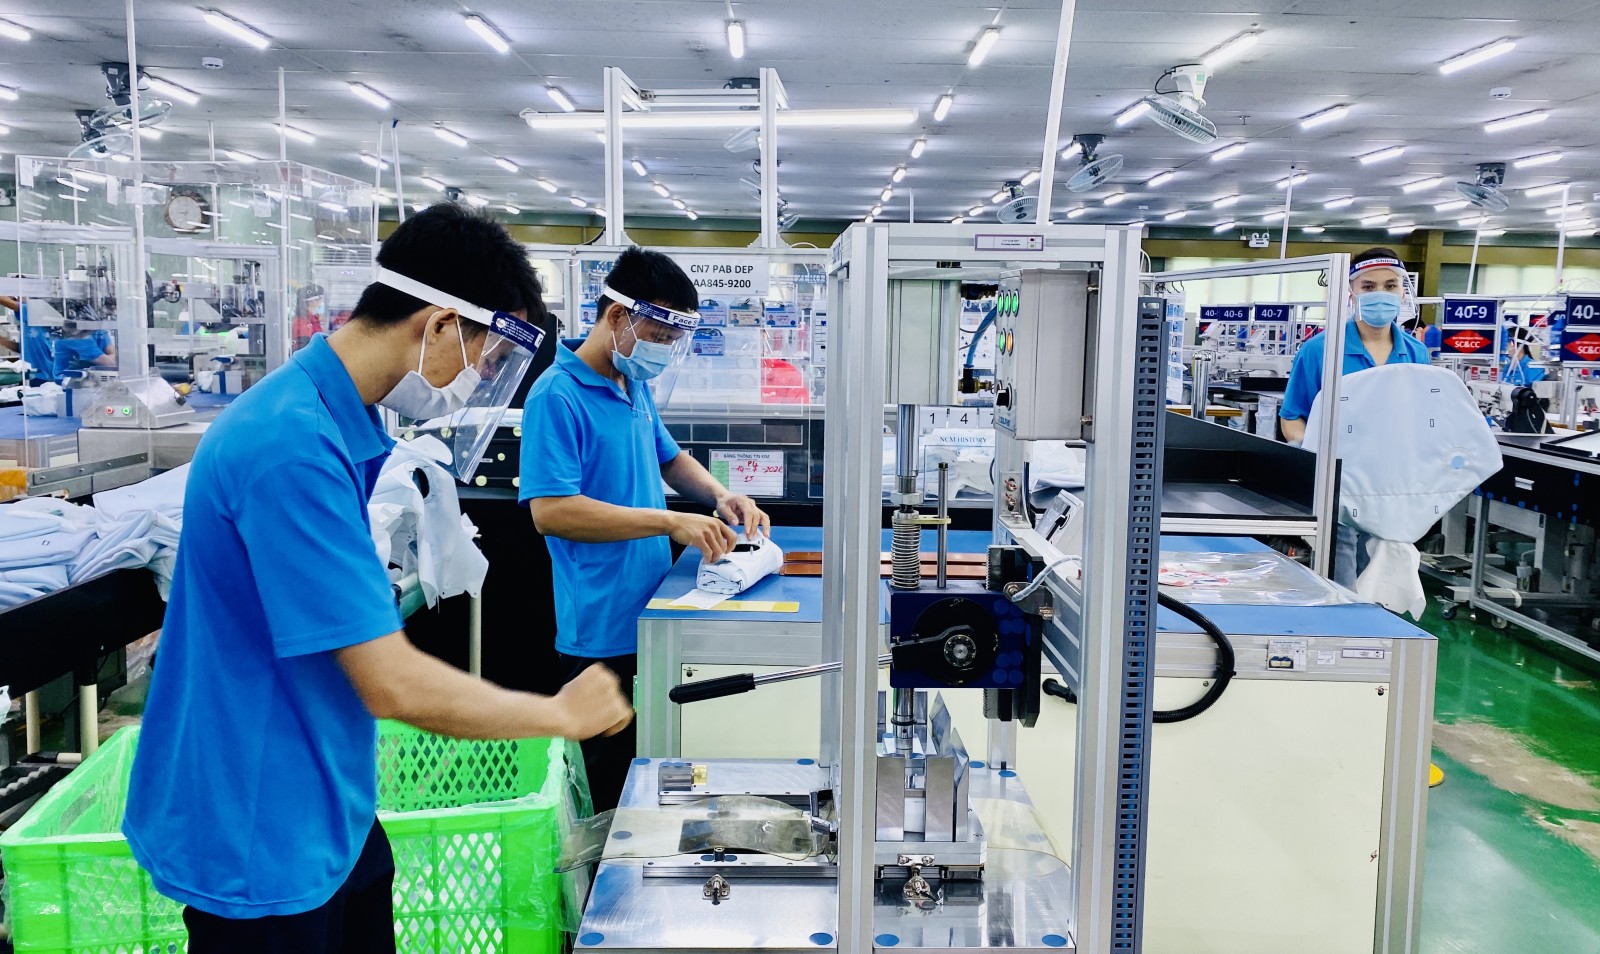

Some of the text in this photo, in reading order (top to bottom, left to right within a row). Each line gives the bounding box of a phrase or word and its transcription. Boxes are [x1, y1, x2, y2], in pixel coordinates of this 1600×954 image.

[690, 264, 754, 274] CN7 PAB DEP
[693, 279, 751, 288] AA845-9200
[1223, 310, 1243, 318] 40-6
[1261, 309, 1283, 318] 40-7
[1454, 306, 1488, 319] 40-9
[673, 315, 692, 325] Face
[1454, 340, 1481, 349] SC&CC
[929, 412, 935, 424] 1
[959, 412, 969, 424] 4
